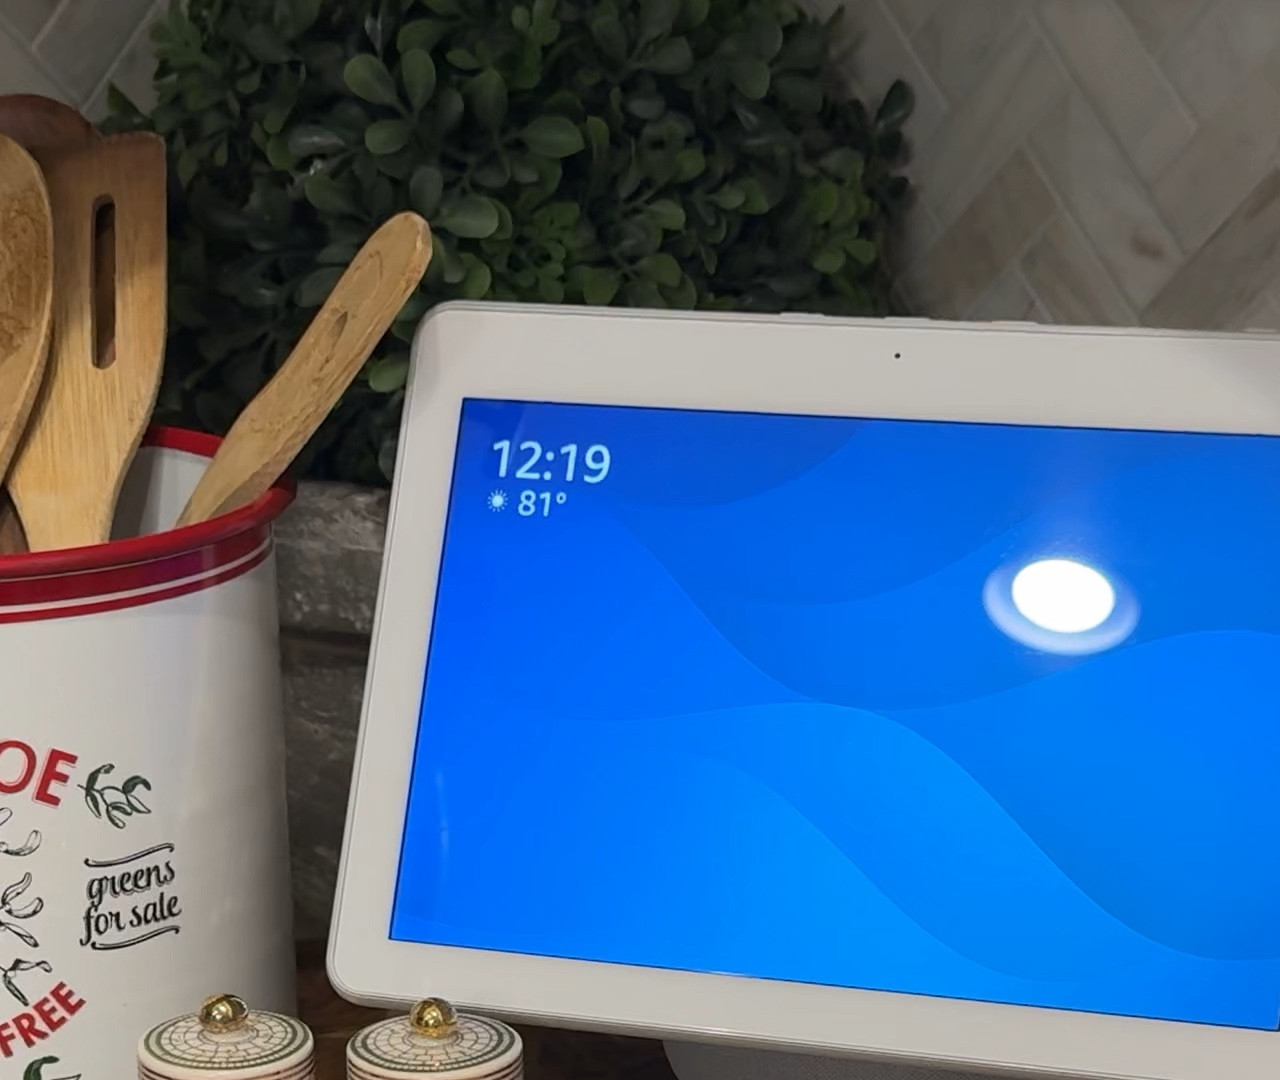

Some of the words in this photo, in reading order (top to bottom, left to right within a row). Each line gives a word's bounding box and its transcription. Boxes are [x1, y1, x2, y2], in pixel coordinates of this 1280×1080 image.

[493, 440, 610, 483] 12:19
[518, 490, 567, 516] 81°
[86, 861, 175, 910] greens
[80, 902, 126, 946] for
[129, 891, 182, 928] sale
